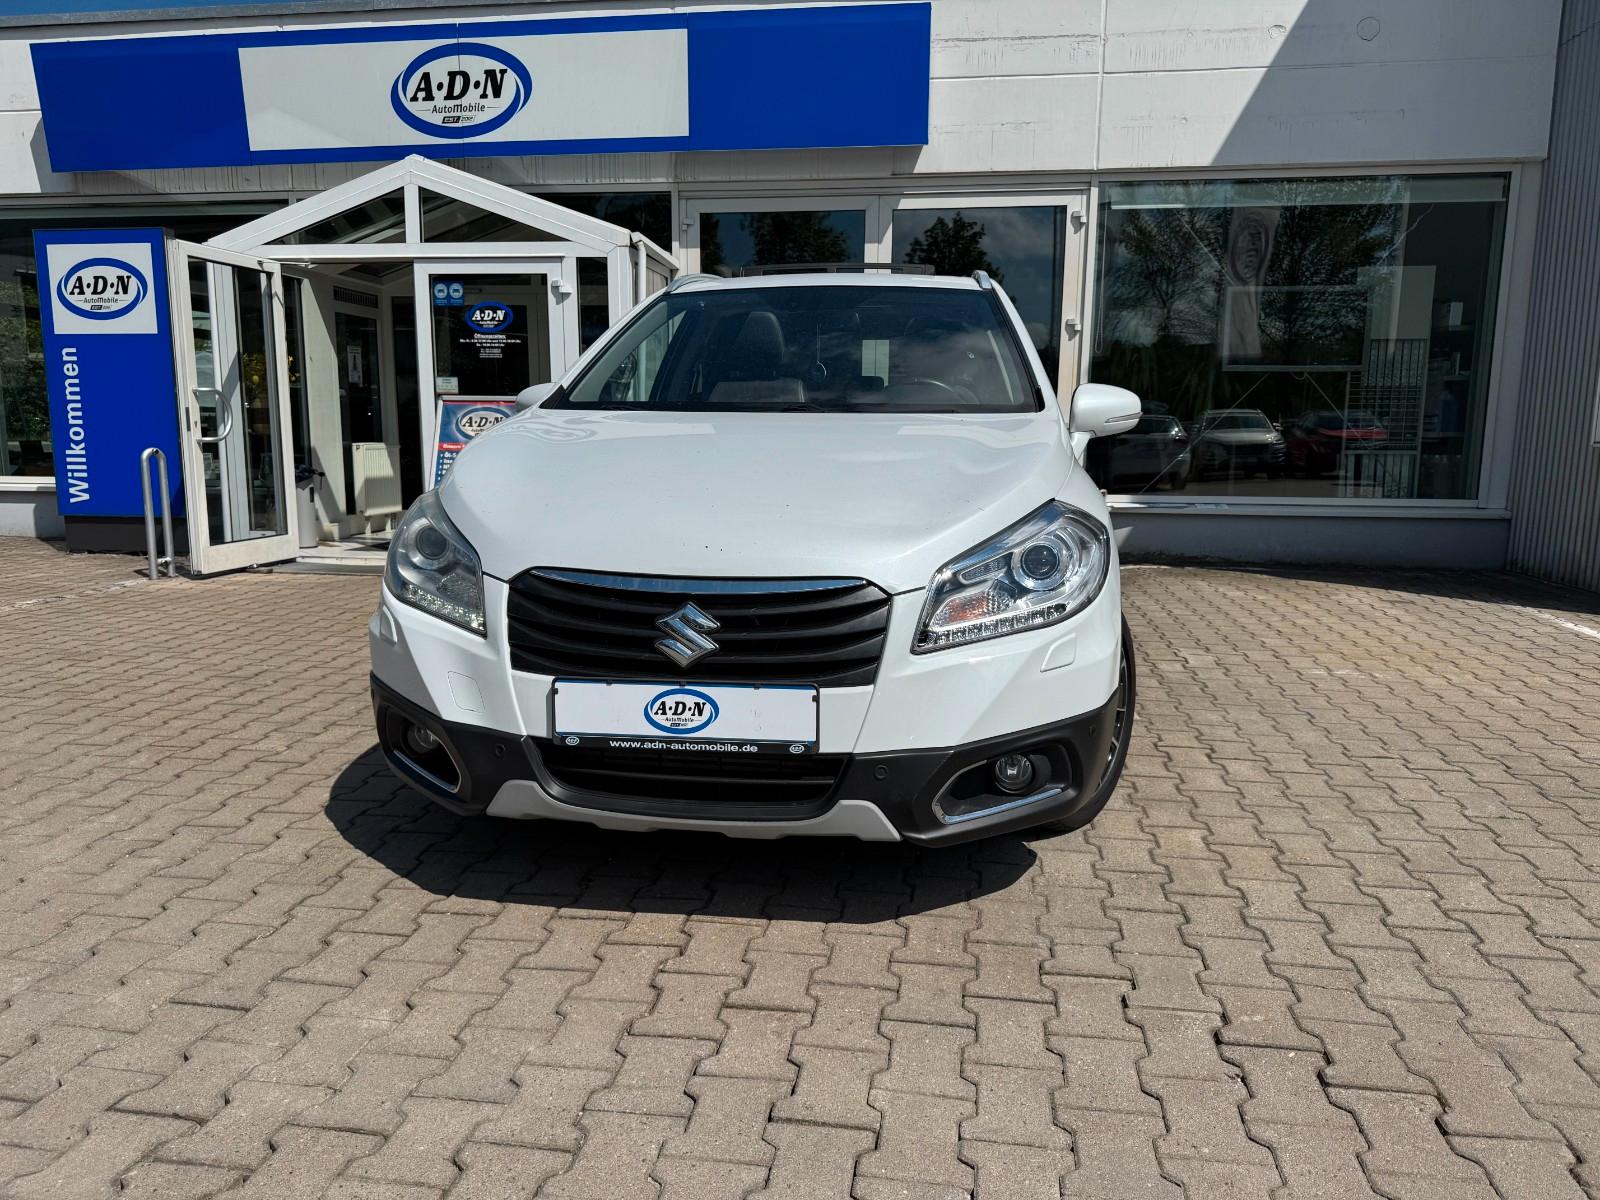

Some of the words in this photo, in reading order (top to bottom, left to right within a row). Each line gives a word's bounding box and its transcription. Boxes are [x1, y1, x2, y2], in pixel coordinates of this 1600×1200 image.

[410, 69, 508, 102] A·D·N
[432, 103, 486, 114] AutoMobile
[69, 275, 132, 295] A·D·N
[61, 347, 90, 503] Willkommen
[654, 700, 707, 716] A·D·N
[609, 740, 758, 753] www.adn-automobile.de
